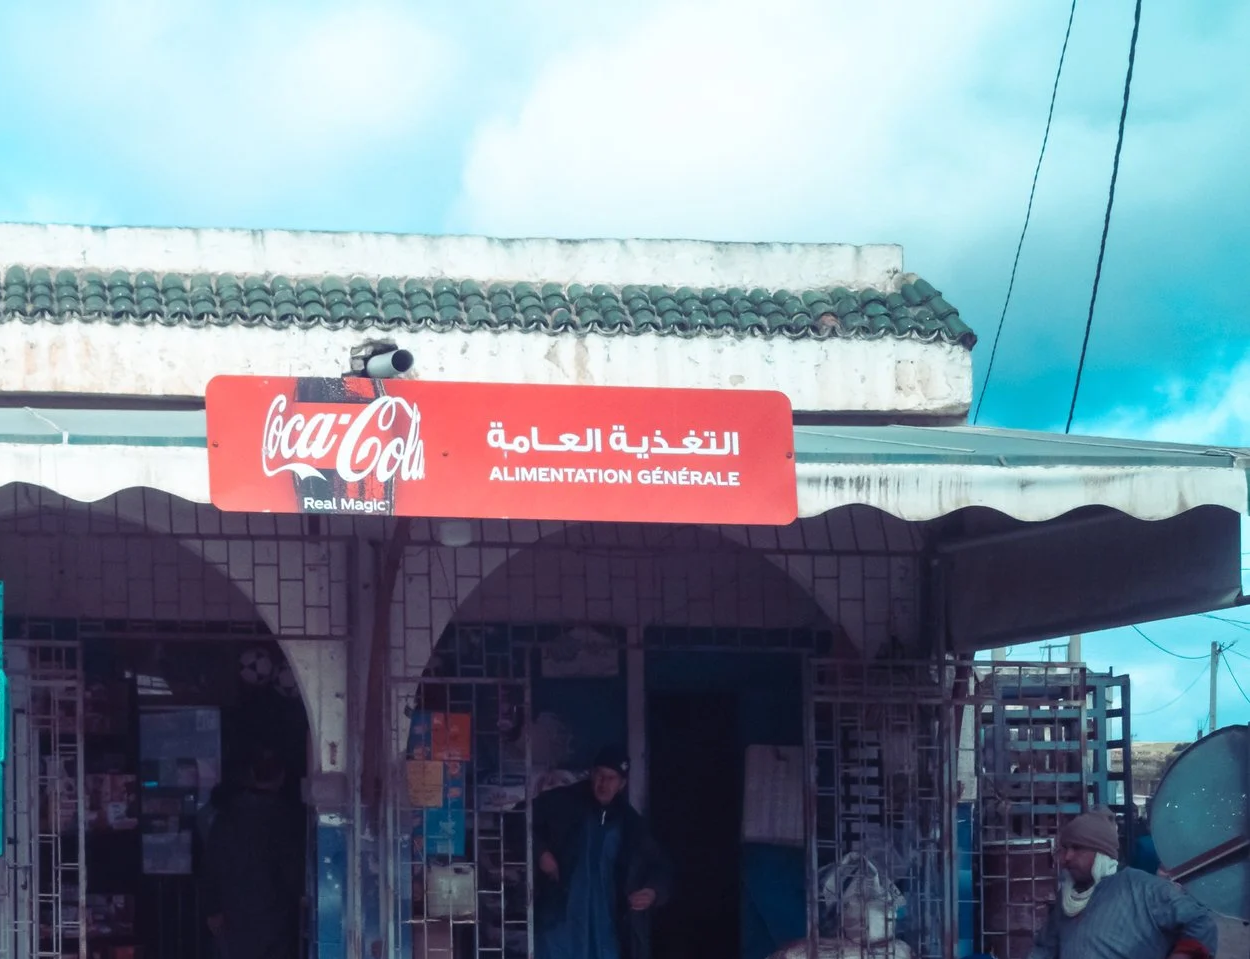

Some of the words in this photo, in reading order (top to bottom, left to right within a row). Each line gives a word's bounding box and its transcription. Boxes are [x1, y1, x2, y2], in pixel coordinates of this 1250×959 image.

[261, 393, 426, 483] Coca-Cola
[486, 421, 603, 454] العامة
[608, 424, 740, 459] التغذية
[489, 465, 633, 484] ALIMENTATION
[636, 466, 741, 487] GÉNÉRALE
[303, 497, 338, 510] Real
[340, 498, 386, 513] Magic
